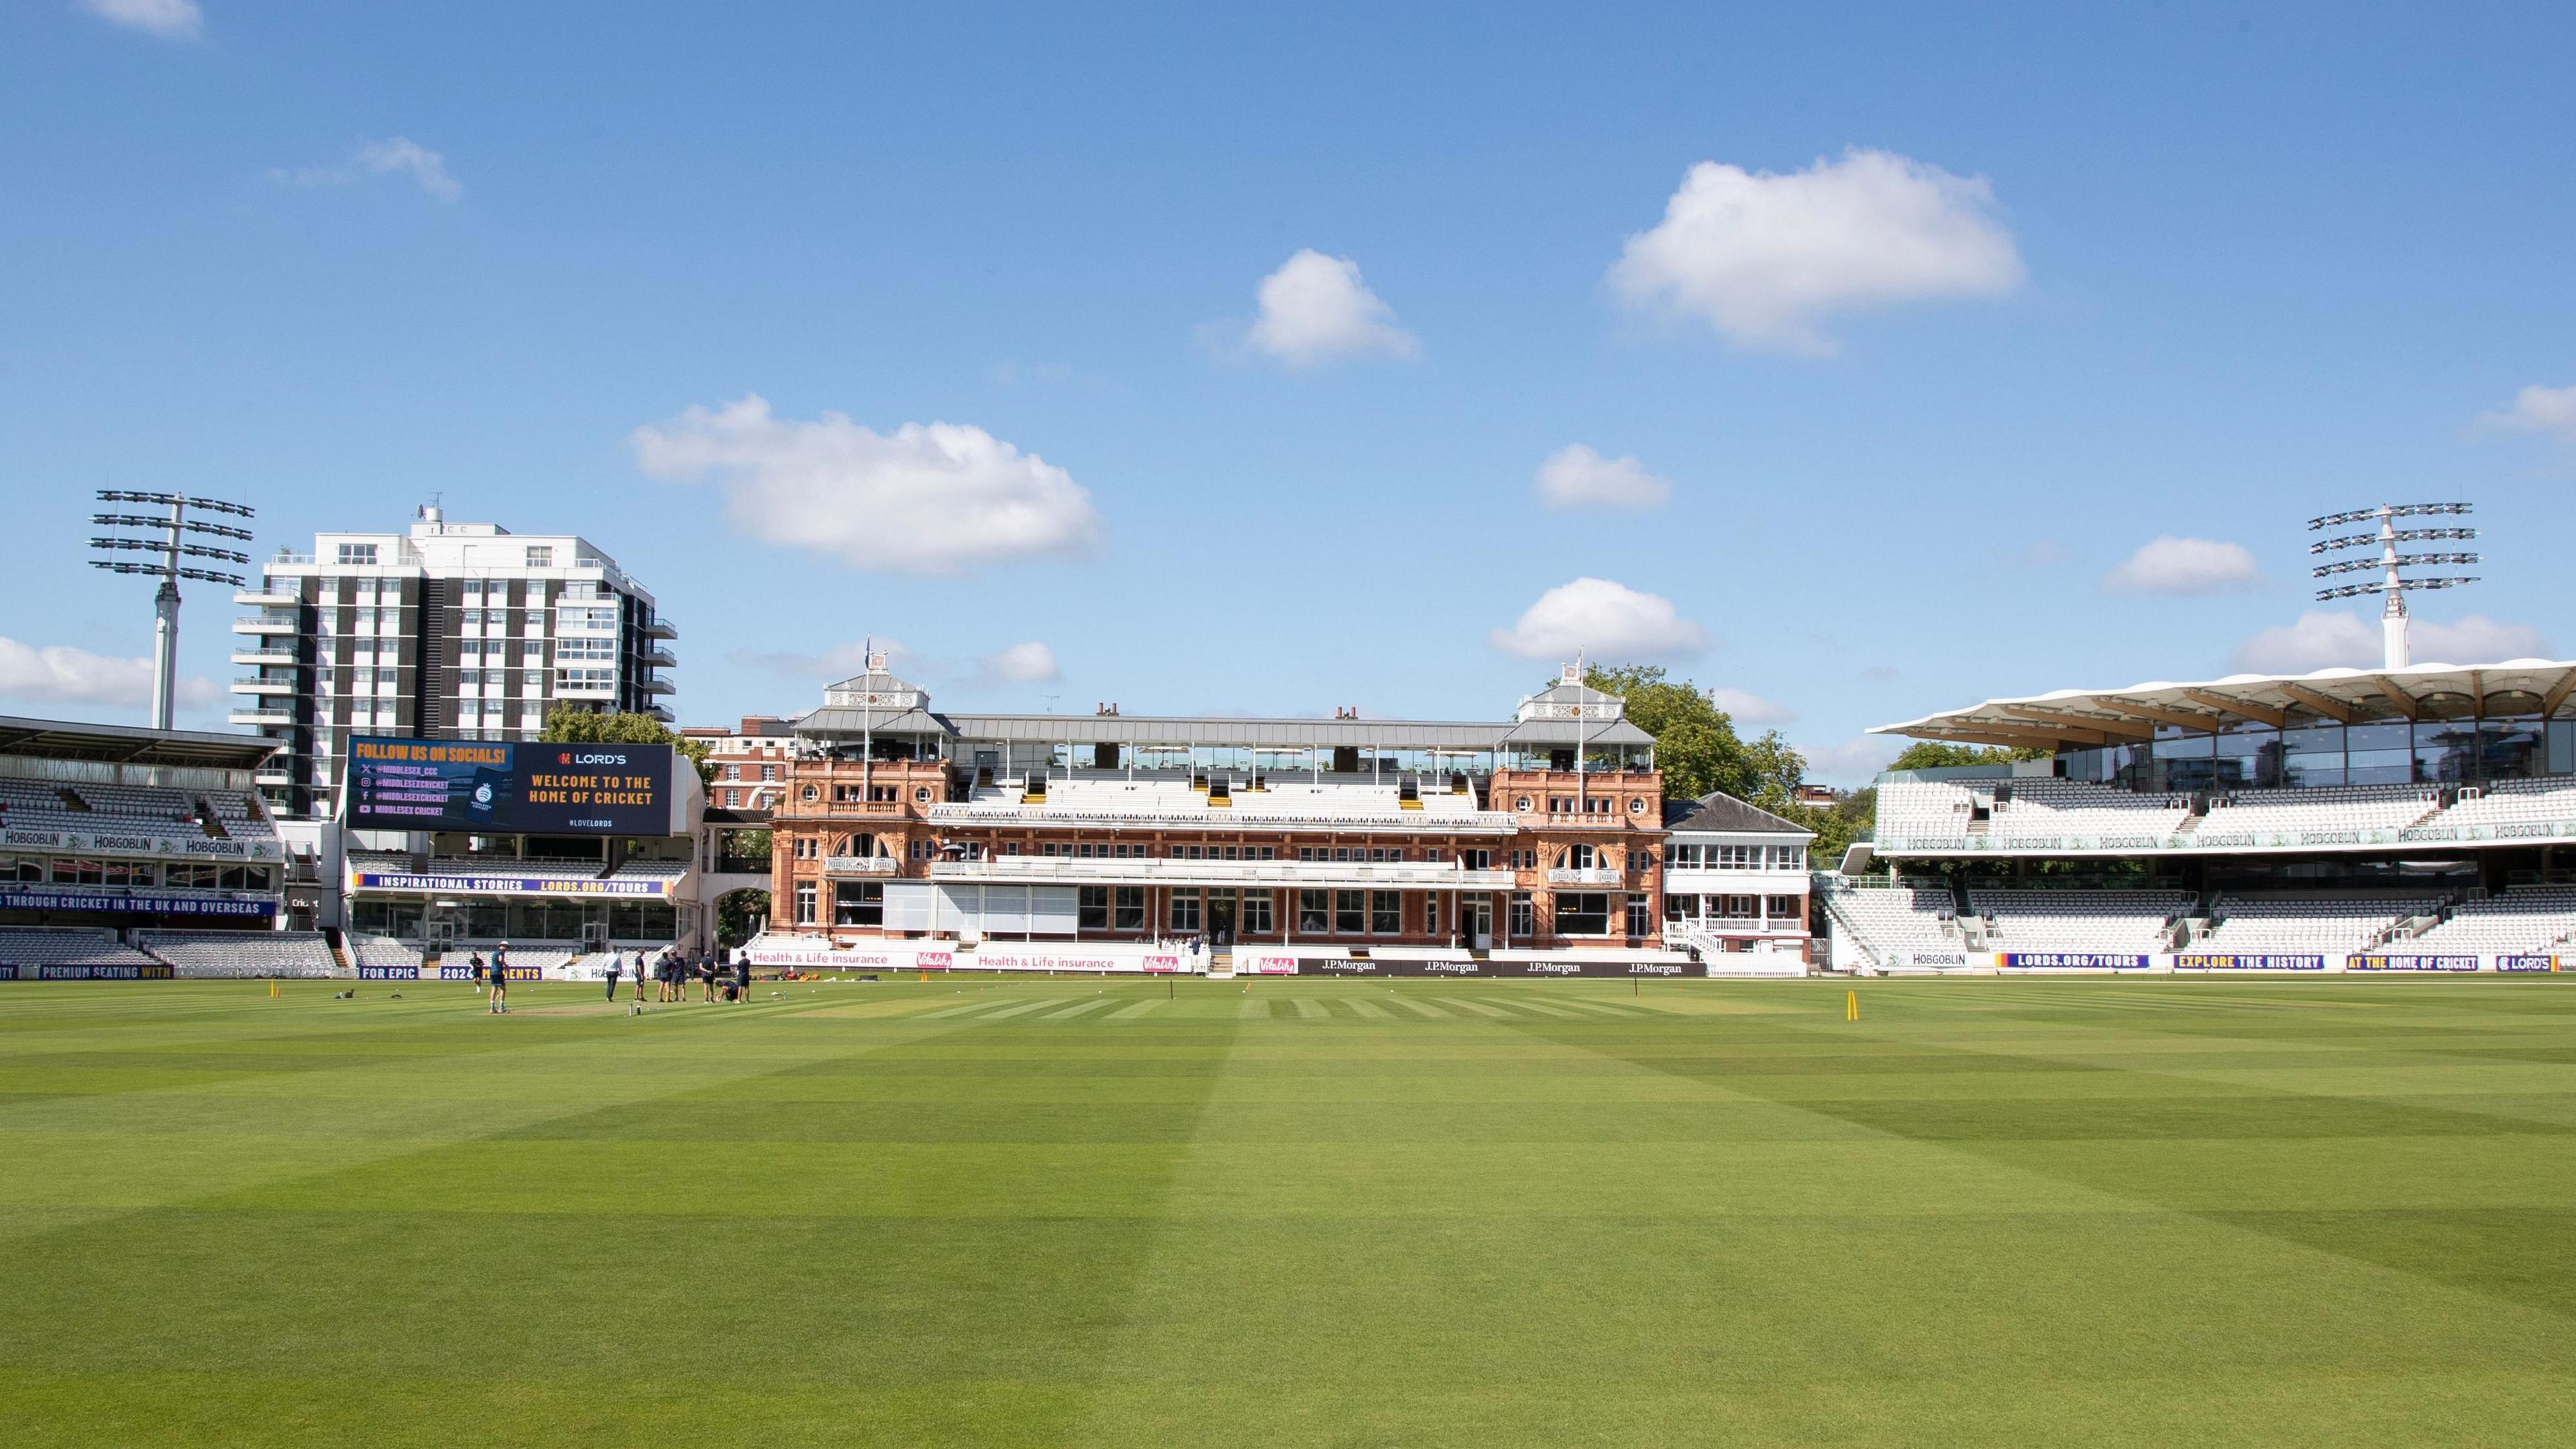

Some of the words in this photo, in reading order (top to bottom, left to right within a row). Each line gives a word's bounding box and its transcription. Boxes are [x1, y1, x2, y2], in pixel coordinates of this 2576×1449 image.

[356, 743, 409, 759] FOLLOW
[411, 747, 427, 761] US
[430, 747, 446, 761] ON
[449, 748, 505, 763] SOCIALS!
[576, 754, 627, 764] LORD'S
[376, 765, 437, 776] @MIDDLESEX_CCC
[376, 779, 449, 790] @MIDDLESEXCRICKET
[531, 775, 598, 788] WELCOME
[602, 776, 620, 788] TO
[625, 777, 651, 789] THE
[376, 792, 449, 802] @MIDDLESEXCRICKET
[529, 790, 567, 803] HOME
[572, 792, 589, 803] OF
[594, 792, 652, 804] CRICKET
[375, 805, 414, 815] MIDDLESEX
[415, 806, 443, 816] CRICKET
[570, 819, 612, 827] #LOVELORDS
[5, 830, 60, 846] HOBGOBLIN
[95, 835, 151, 850] HOBGOBLIN
[186, 840, 244, 855] HOBGOBLIN
[379, 876, 470, 890] INSPIRATIONAL
[474, 879, 523, 890] STORIES
[541, 881, 648, 893] LORDS.ORG/TOURS
[6, 896, 57, 907] THROUGH
[61, 898, 109, 908] CRICKET
[113, 899, 125, 910] IN
[129, 900, 151, 910] THE
[155, 900, 170, 911] UK
[174, 901, 197, 912] AND
[201, 902, 260, 913] OVERSEAS
[753, 953, 792, 963] Health
[796, 955, 803, 963] &
[806, 953, 828, 963] Life
[833, 953, 888, 964] insurance
[917, 953, 951, 967] Vitality
[979, 956, 1018, 966] Health
[1021, 958, 1028, 966] &
[1032, 957, 1054, 967] Life
[1059, 957, 1114, 968] insurance
[1143, 957, 1177, 971] Vitality
[1260, 958, 1295, 973] Vitality
[1913, 954, 1966, 965] HOBGOBLIN
[2018, 955, 2139, 967] LORDS.ORG/TOURS
[2180, 956, 2235, 967] EXPLORE
[2239, 957, 2262, 967] THE
[2267, 957, 2319, 968] HISTORY
[2349, 957, 2362, 968] AT
[2365, 957, 2386, 969] THE
[2389, 957, 2418, 969] HOME
[2420, 957, 2434, 969] OF
[2436, 957, 2476, 969] CRICKET
[2512, 957, 2549, 969] LORD'S
[1322, 960, 1376, 972] J.P.Morgan
[1424, 961, 1478, 973] J.P.Morgan
[1527, 962, 1580, 973] J.P.Morgan
[1629, 963, 1682, 975] J.P.Morgan
[43, 967, 90, 978] PREMIUM
[93, 967, 138, 978] SEATING
[142, 967, 170, 978] WITH
[363, 968, 385, 979] FOR
[389, 968, 415, 979] EPIC
